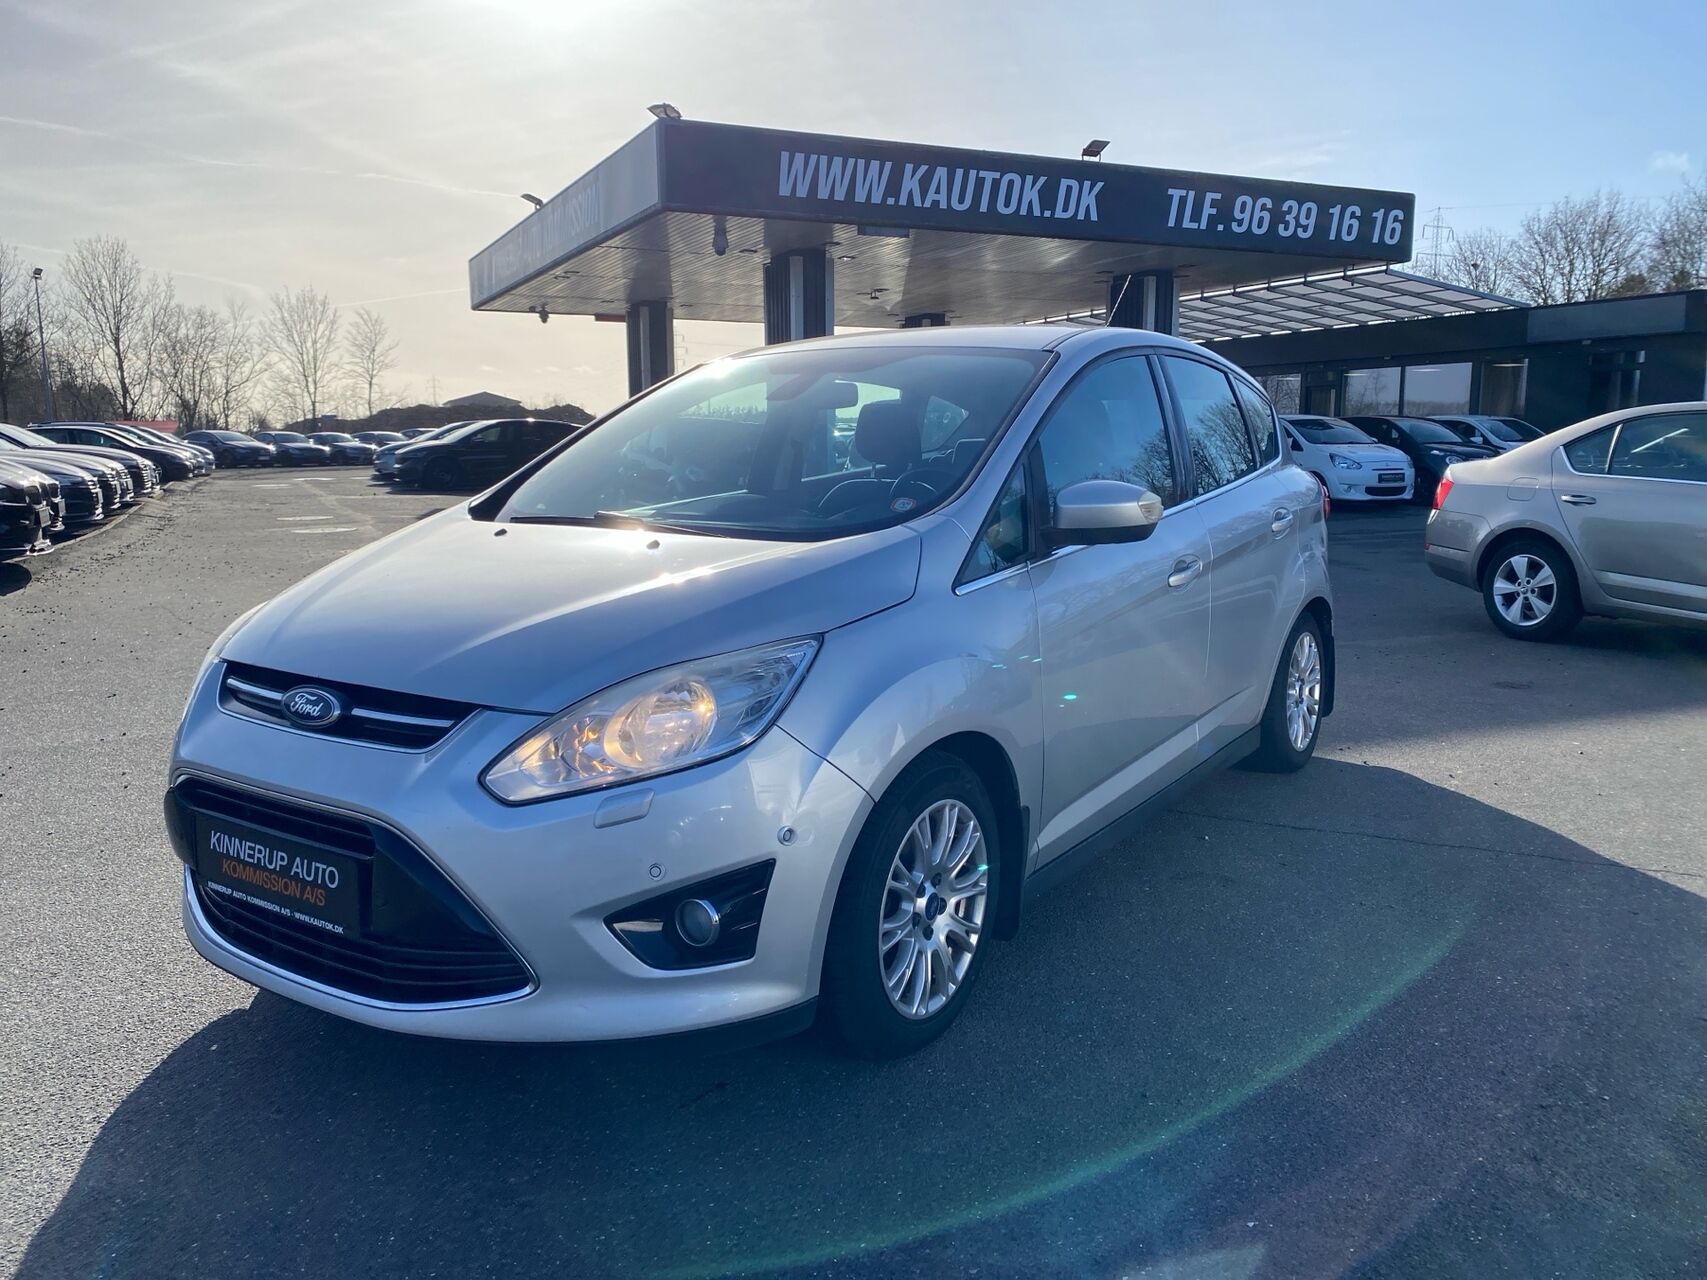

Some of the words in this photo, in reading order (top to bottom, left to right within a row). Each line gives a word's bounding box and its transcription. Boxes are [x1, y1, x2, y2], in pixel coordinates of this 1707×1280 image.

[778, 150, 1105, 222] WWW.KAUTOK.DK
[1167, 188, 1224, 231] TLF.
[1231, 195, 1273, 235] 96
[1278, 199, 1318, 239] 39
[1328, 204, 1361, 242] 16
[1371, 208, 1405, 245] 16
[290, 692, 324, 717] Ford
[210, 830, 288, 872] KINNERUP
[290, 856, 339, 889] AUTO
[222, 859, 301, 898] KOMMISSION
[302, 885, 326, 906] A/S
[233, 890, 247, 901] AUTO
